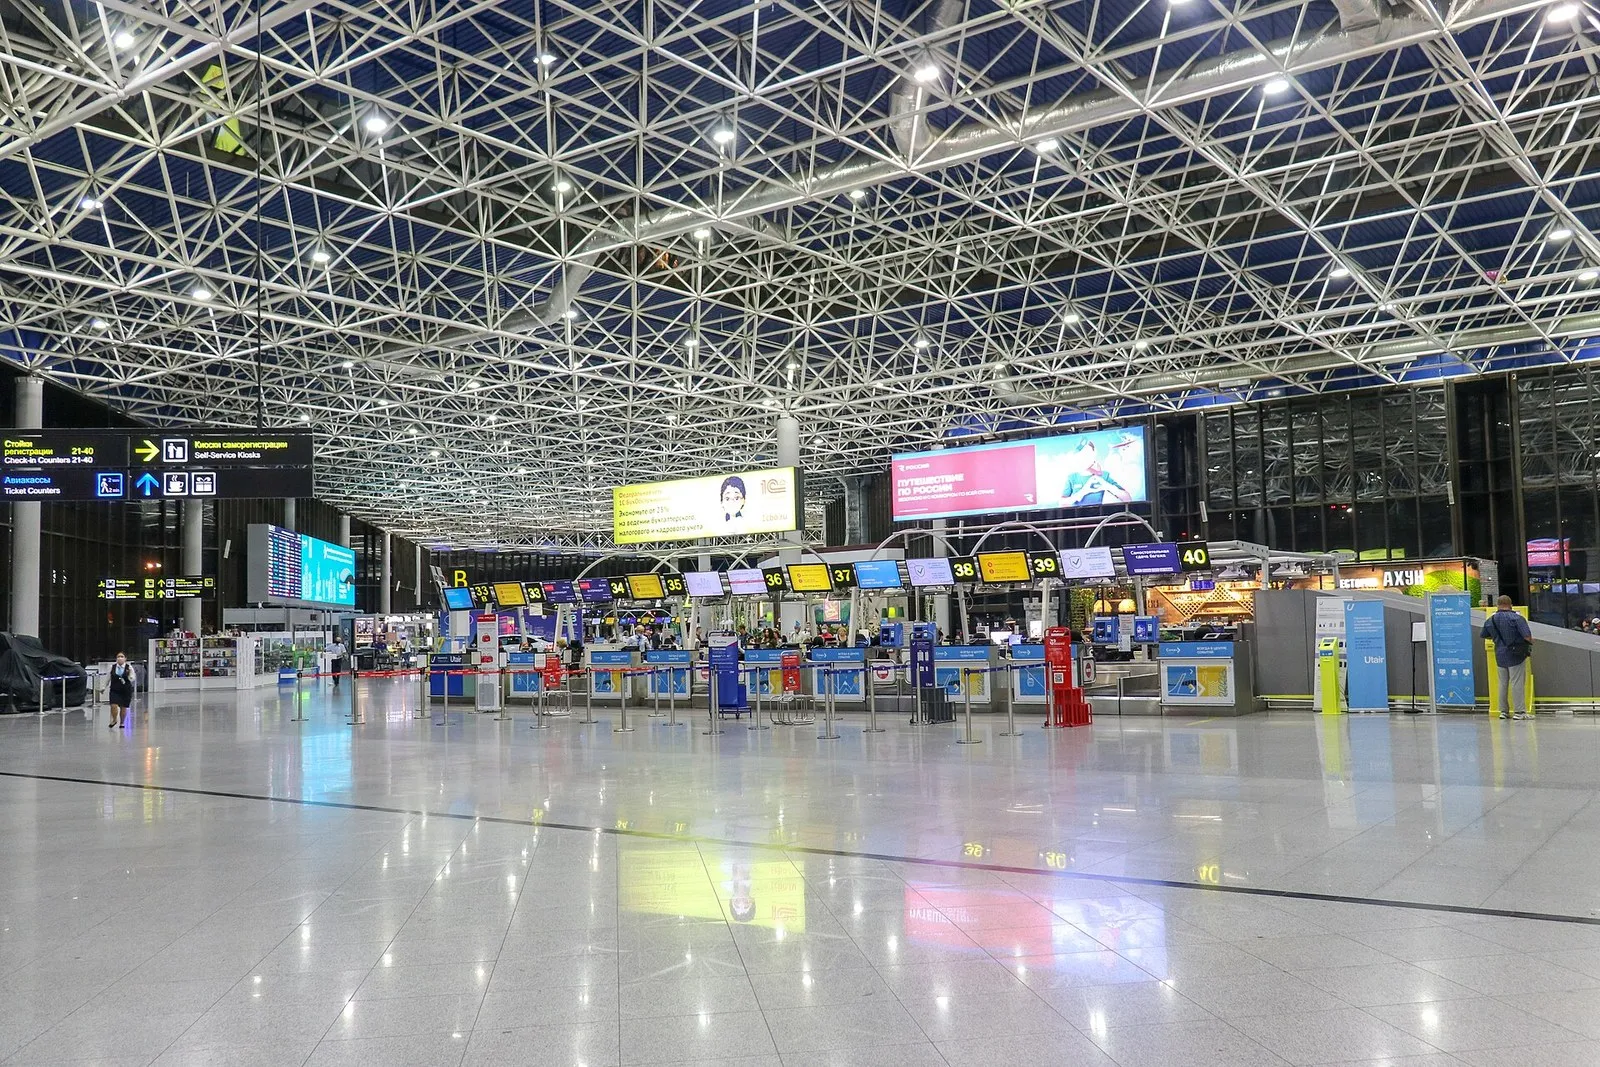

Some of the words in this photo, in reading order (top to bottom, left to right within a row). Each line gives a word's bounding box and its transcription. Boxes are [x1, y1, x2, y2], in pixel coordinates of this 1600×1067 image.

[4, 440, 33, 448] Стойки
[223, 441, 288, 450] саморегистрации
[4, 448, 54, 456] регистрации
[71, 447, 94, 455] 21-40
[4, 476, 51, 484] Авиакассы
[897, 473, 964, 488] ПУТЕШЕСТВИЕ
[898, 487, 912, 496] ПО
[913, 484, 953, 495] РОССИИ
[618, 528, 650, 536] налогового
[1183, 548, 1206, 564] 40
[954, 562, 974, 577] 38
[1034, 558, 1056, 573] 39
[765, 572, 782, 587] 36
[834, 569, 850, 582] 37
[1383, 569, 1425, 587] АХУН
[474, 585, 489, 596] 33
[610, 582, 625, 594] 34
[667, 578, 682, 591] 35
[528, 588, 542, 599] 33
[1364, 656, 1384, 664] Utair
